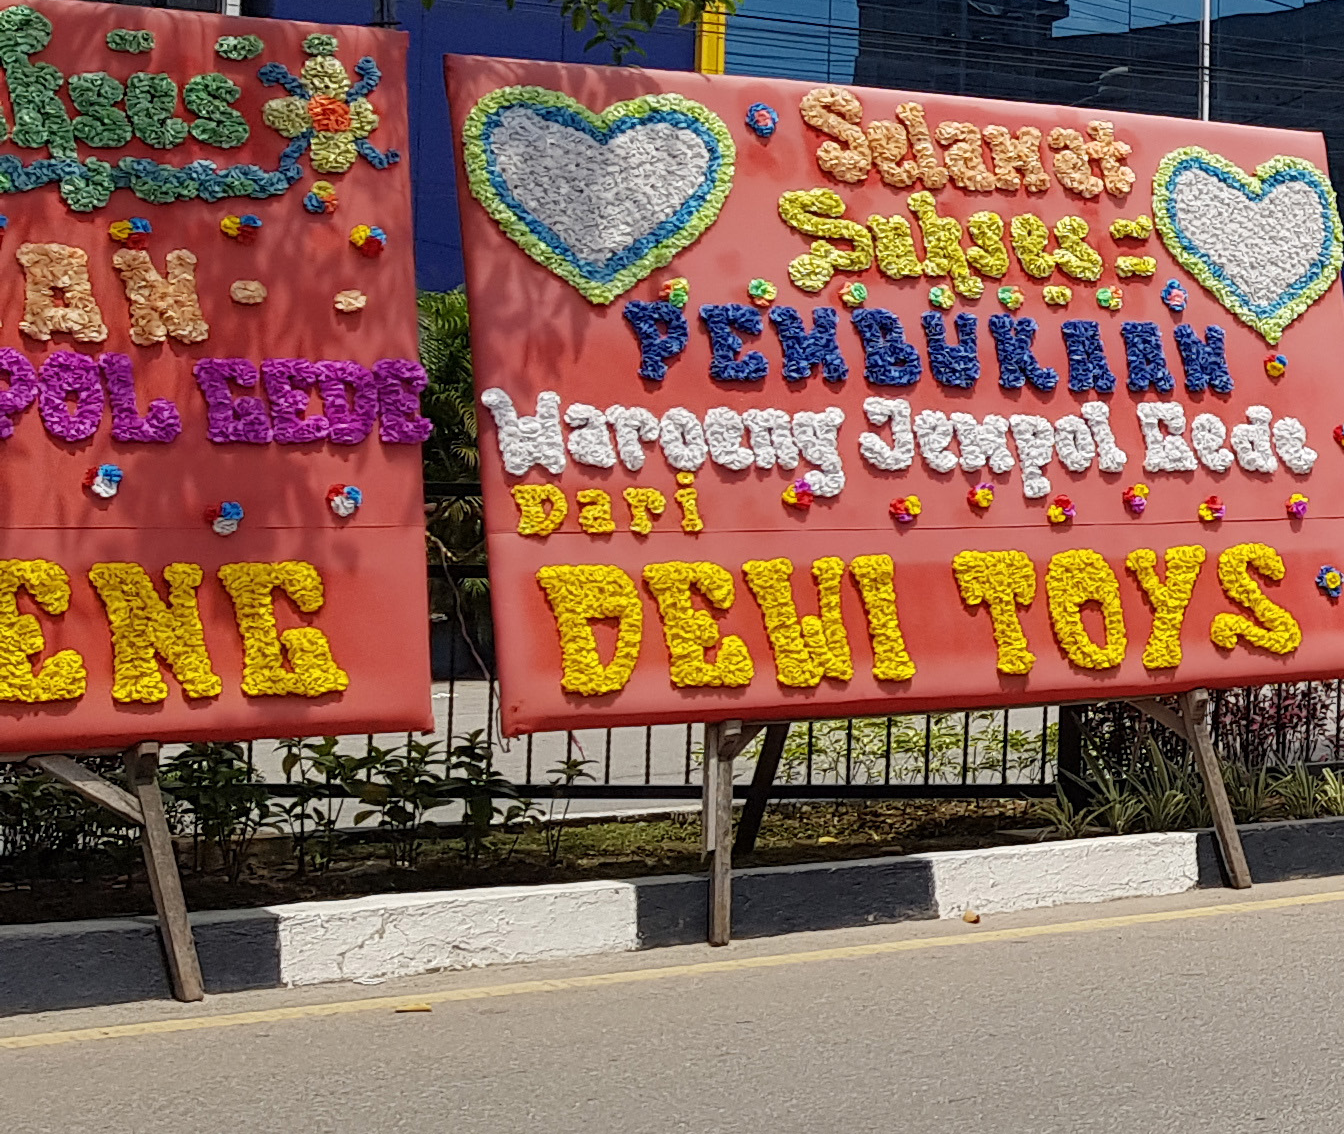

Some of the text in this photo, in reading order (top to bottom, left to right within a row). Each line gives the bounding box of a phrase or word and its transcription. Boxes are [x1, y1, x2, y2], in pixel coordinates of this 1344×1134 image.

[0, 5, 250, 212] kses
[0, 242, 210, 345] AN
[623, 298, 1235, 394] PEMBUKAAN
[481, 387, 845, 497] Waroeng
[858, 396, 1127, 499] Jempol
[510, 471, 704, 537] Dari
[536, 542, 1303, 696] DEWI TOYS
